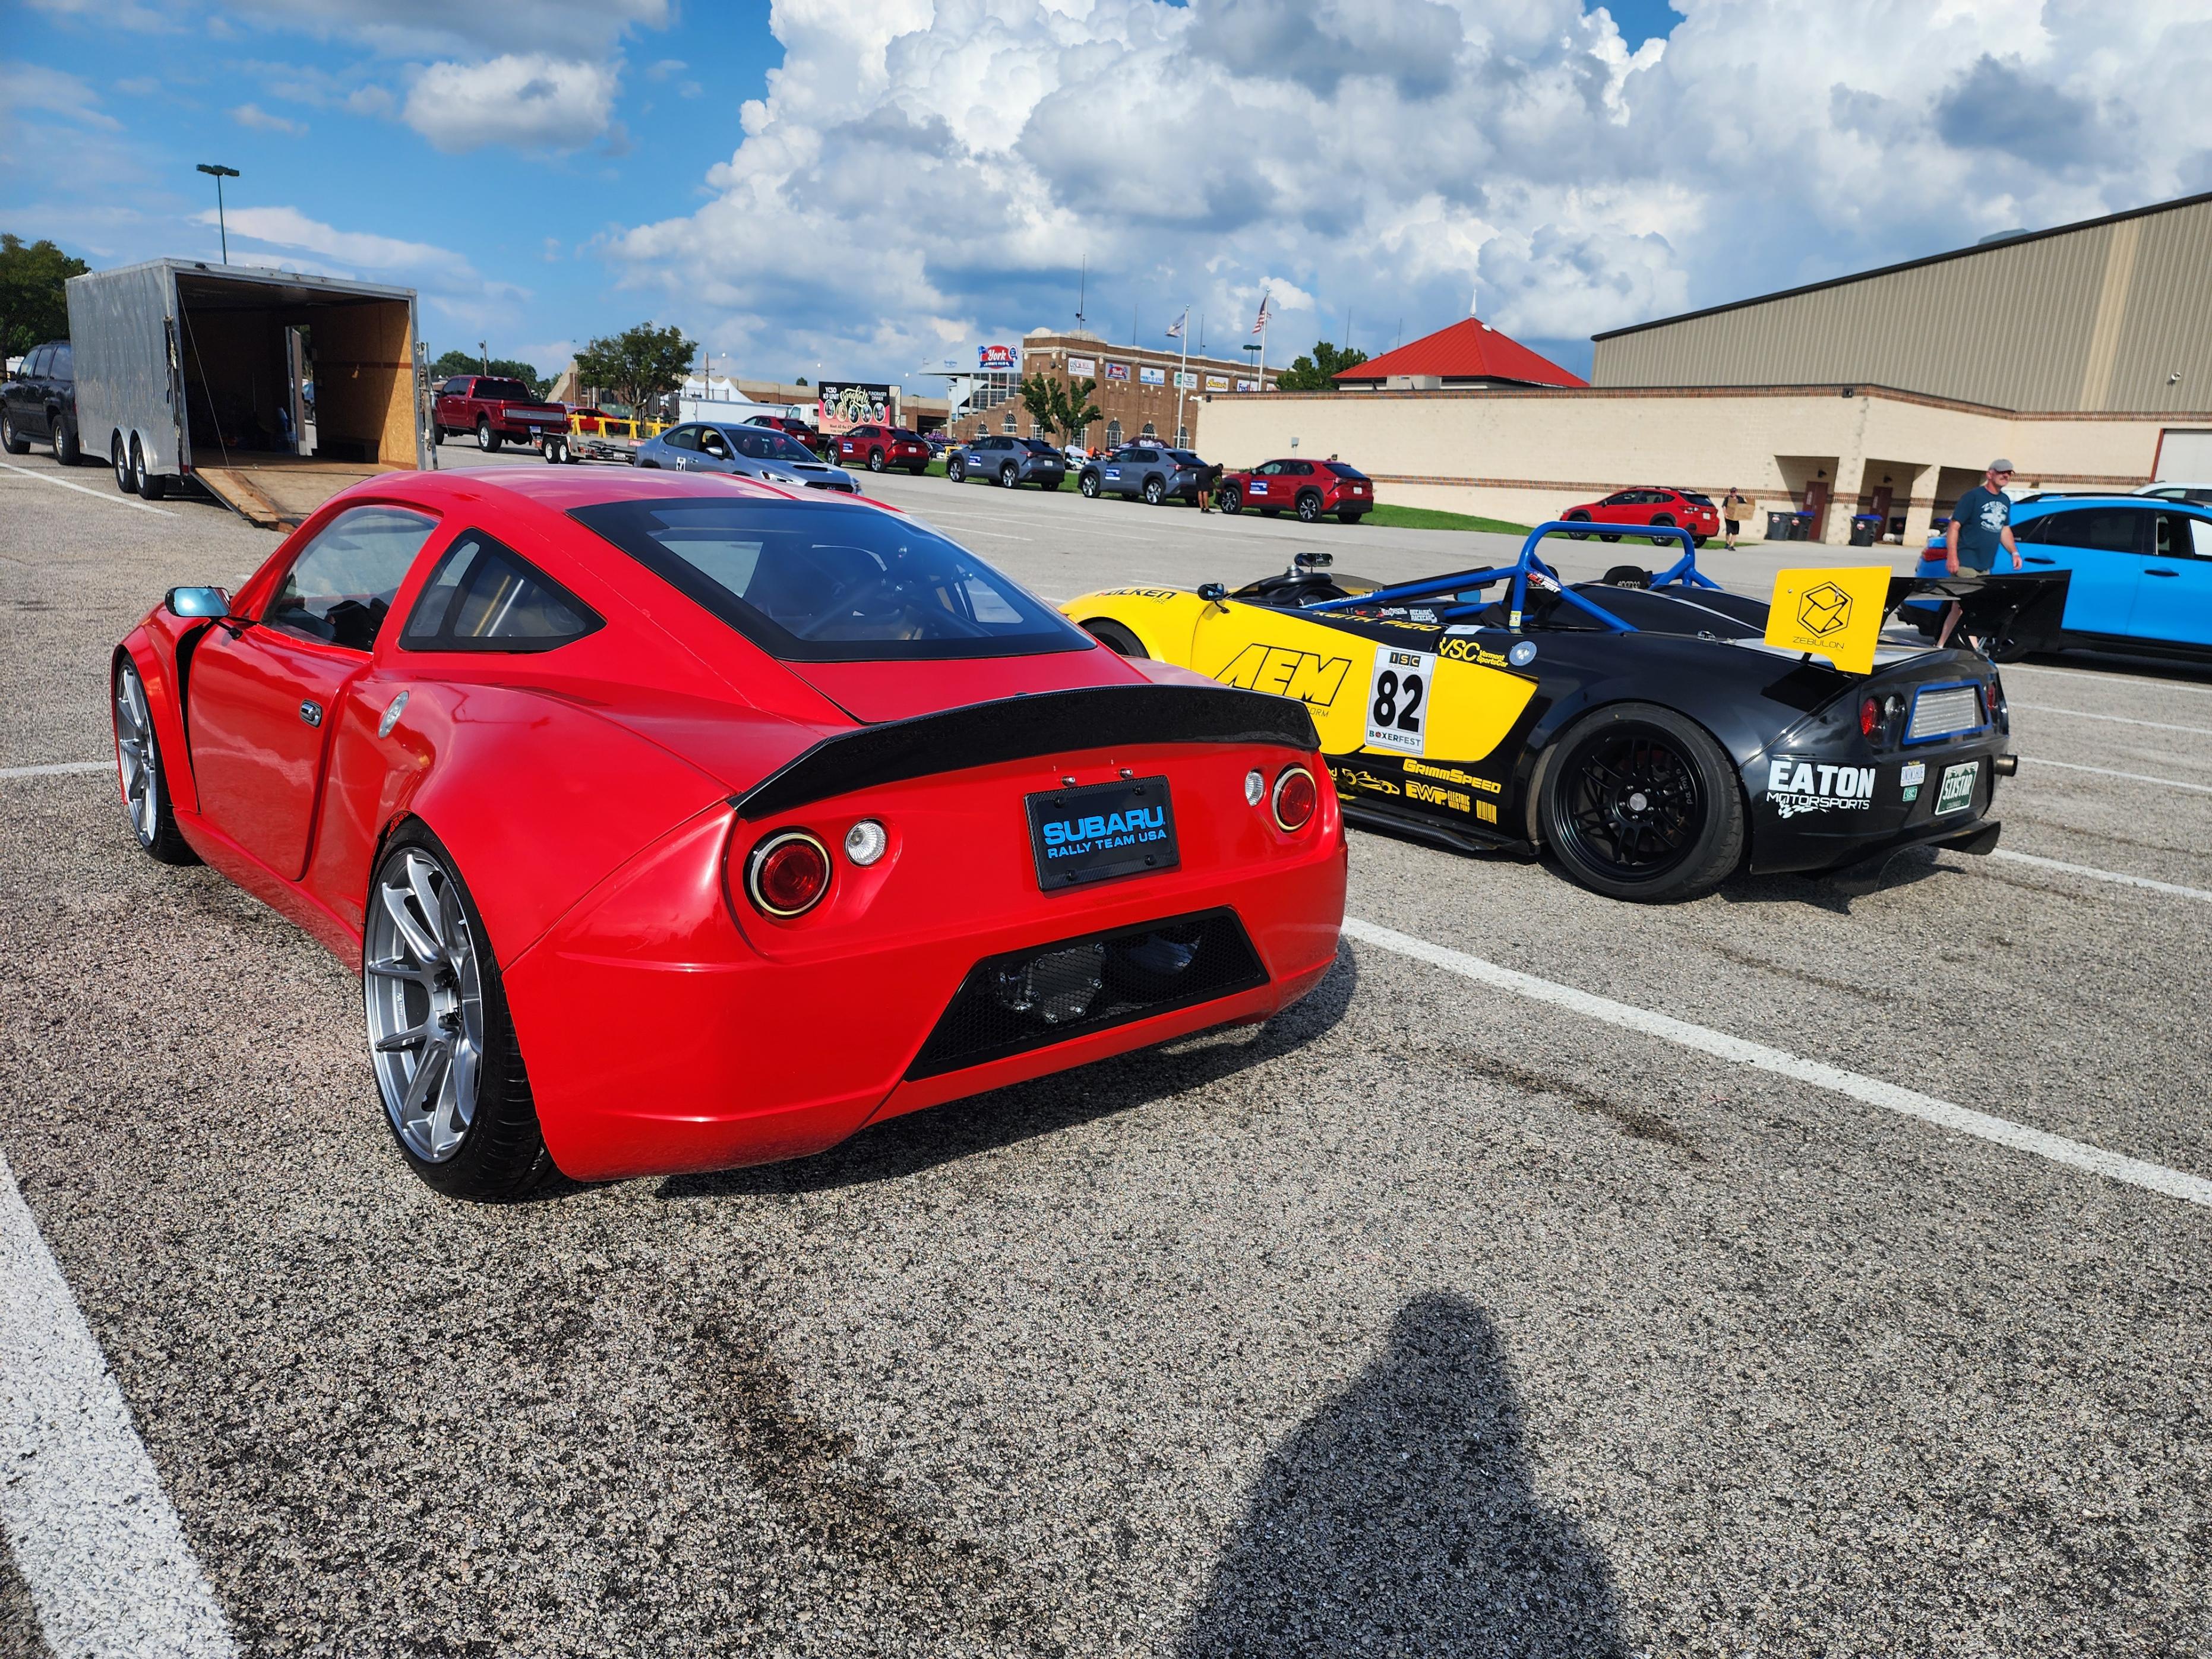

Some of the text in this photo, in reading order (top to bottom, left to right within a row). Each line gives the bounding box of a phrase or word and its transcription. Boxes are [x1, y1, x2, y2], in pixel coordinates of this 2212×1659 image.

[987, 349, 1007, 361] York
[840, 385, 870, 407] Spaghetti
[1439, 636, 1480, 661] VSC
[1793, 636, 1844, 649] ZEBULON
[1392, 653, 1420, 666] ISC
[1477, 655, 1509, 668] SportsCar
[1479, 649, 1505, 660] Vermont
[1214, 643, 1353, 707] AEM
[1388, 663, 1419, 672] SUSPENSION
[1373, 670, 1423, 732] 82
[1369, 730, 1421, 746] BOXERFEST
[1768, 760, 1876, 798] EATON
[1405, 779, 1470, 807] EWP ELECTRIC
[1766, 792, 1870, 810] MOTORSPORTS
[1043, 806, 1164, 845] SUBARU
[1048, 830, 1167, 859] RALLY TEAM USA
